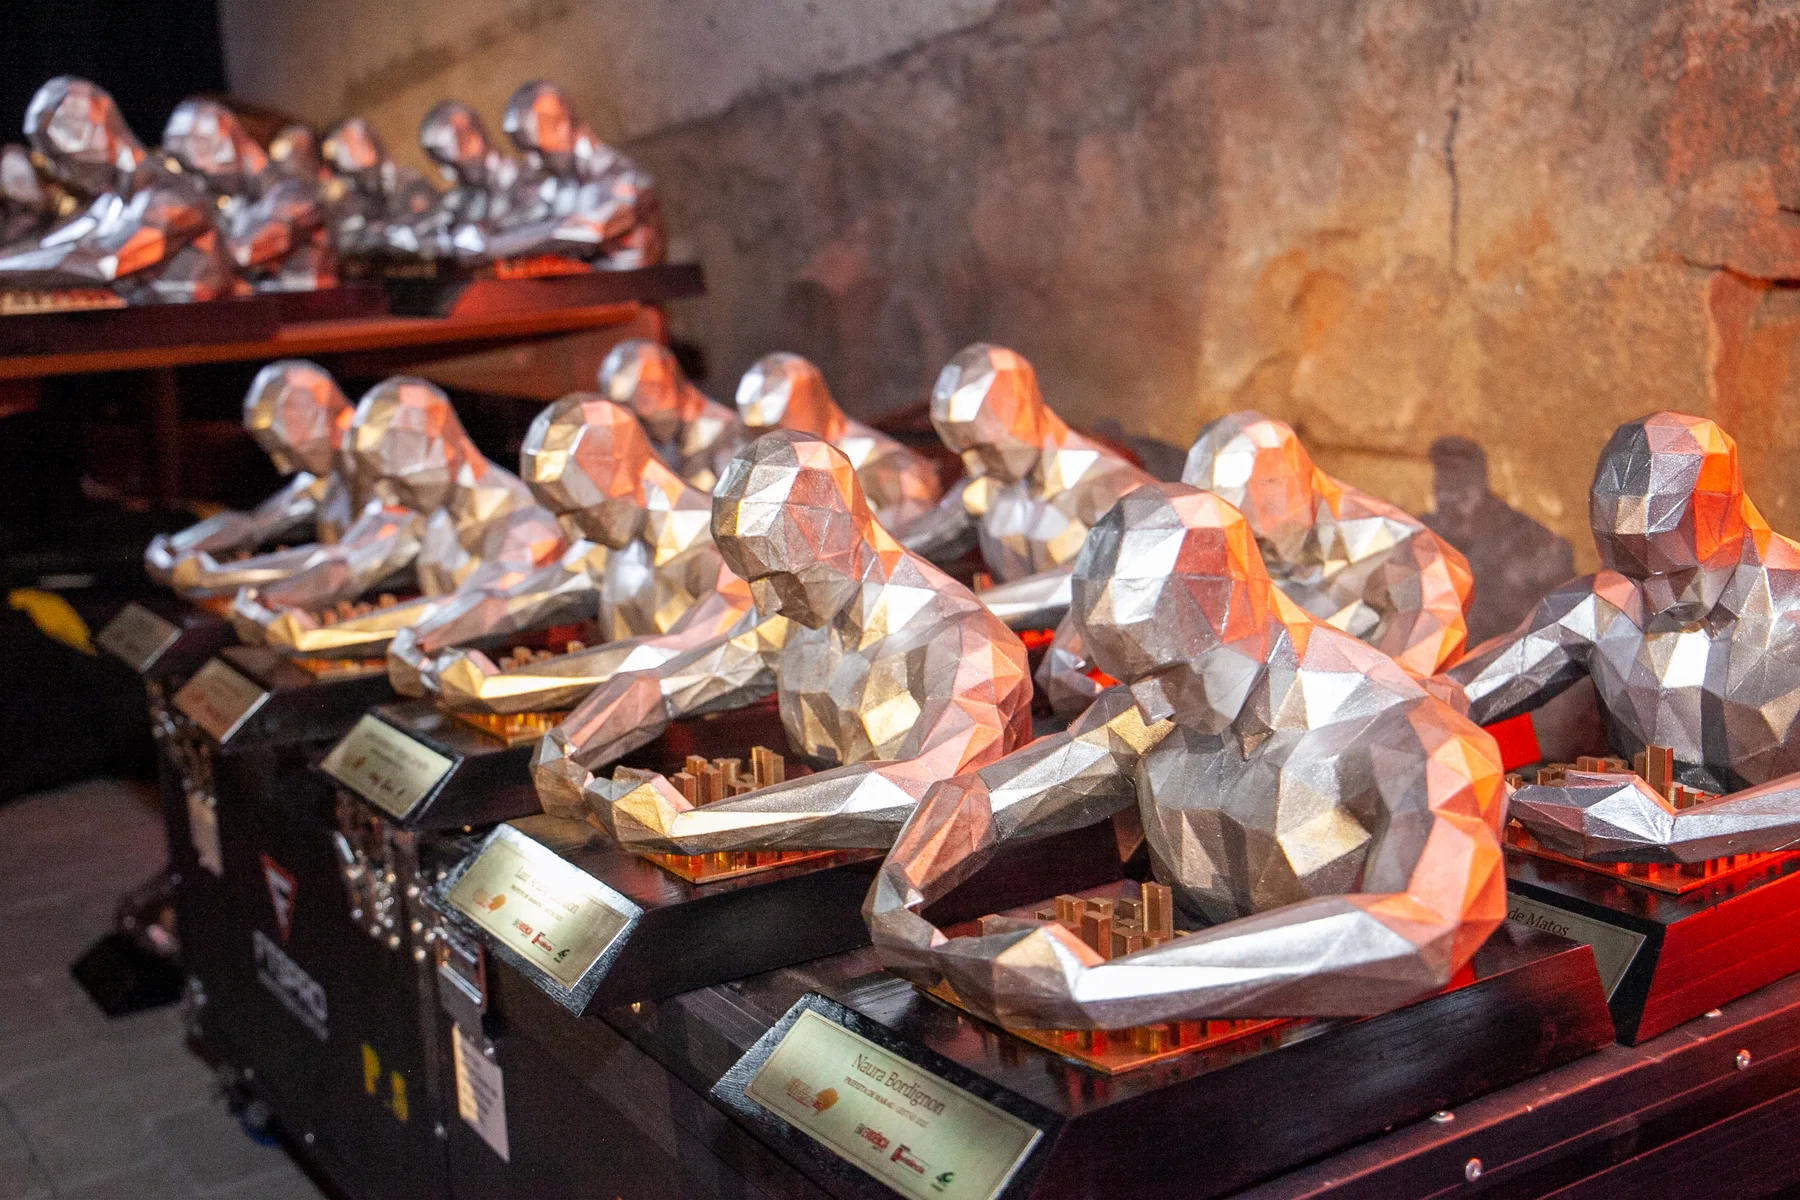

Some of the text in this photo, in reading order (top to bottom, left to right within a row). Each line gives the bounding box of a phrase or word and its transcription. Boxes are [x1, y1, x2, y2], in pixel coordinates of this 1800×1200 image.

[1507, 907, 1570, 936] de Matos
[851, 1053, 946, 1116] Naura Bordignon
